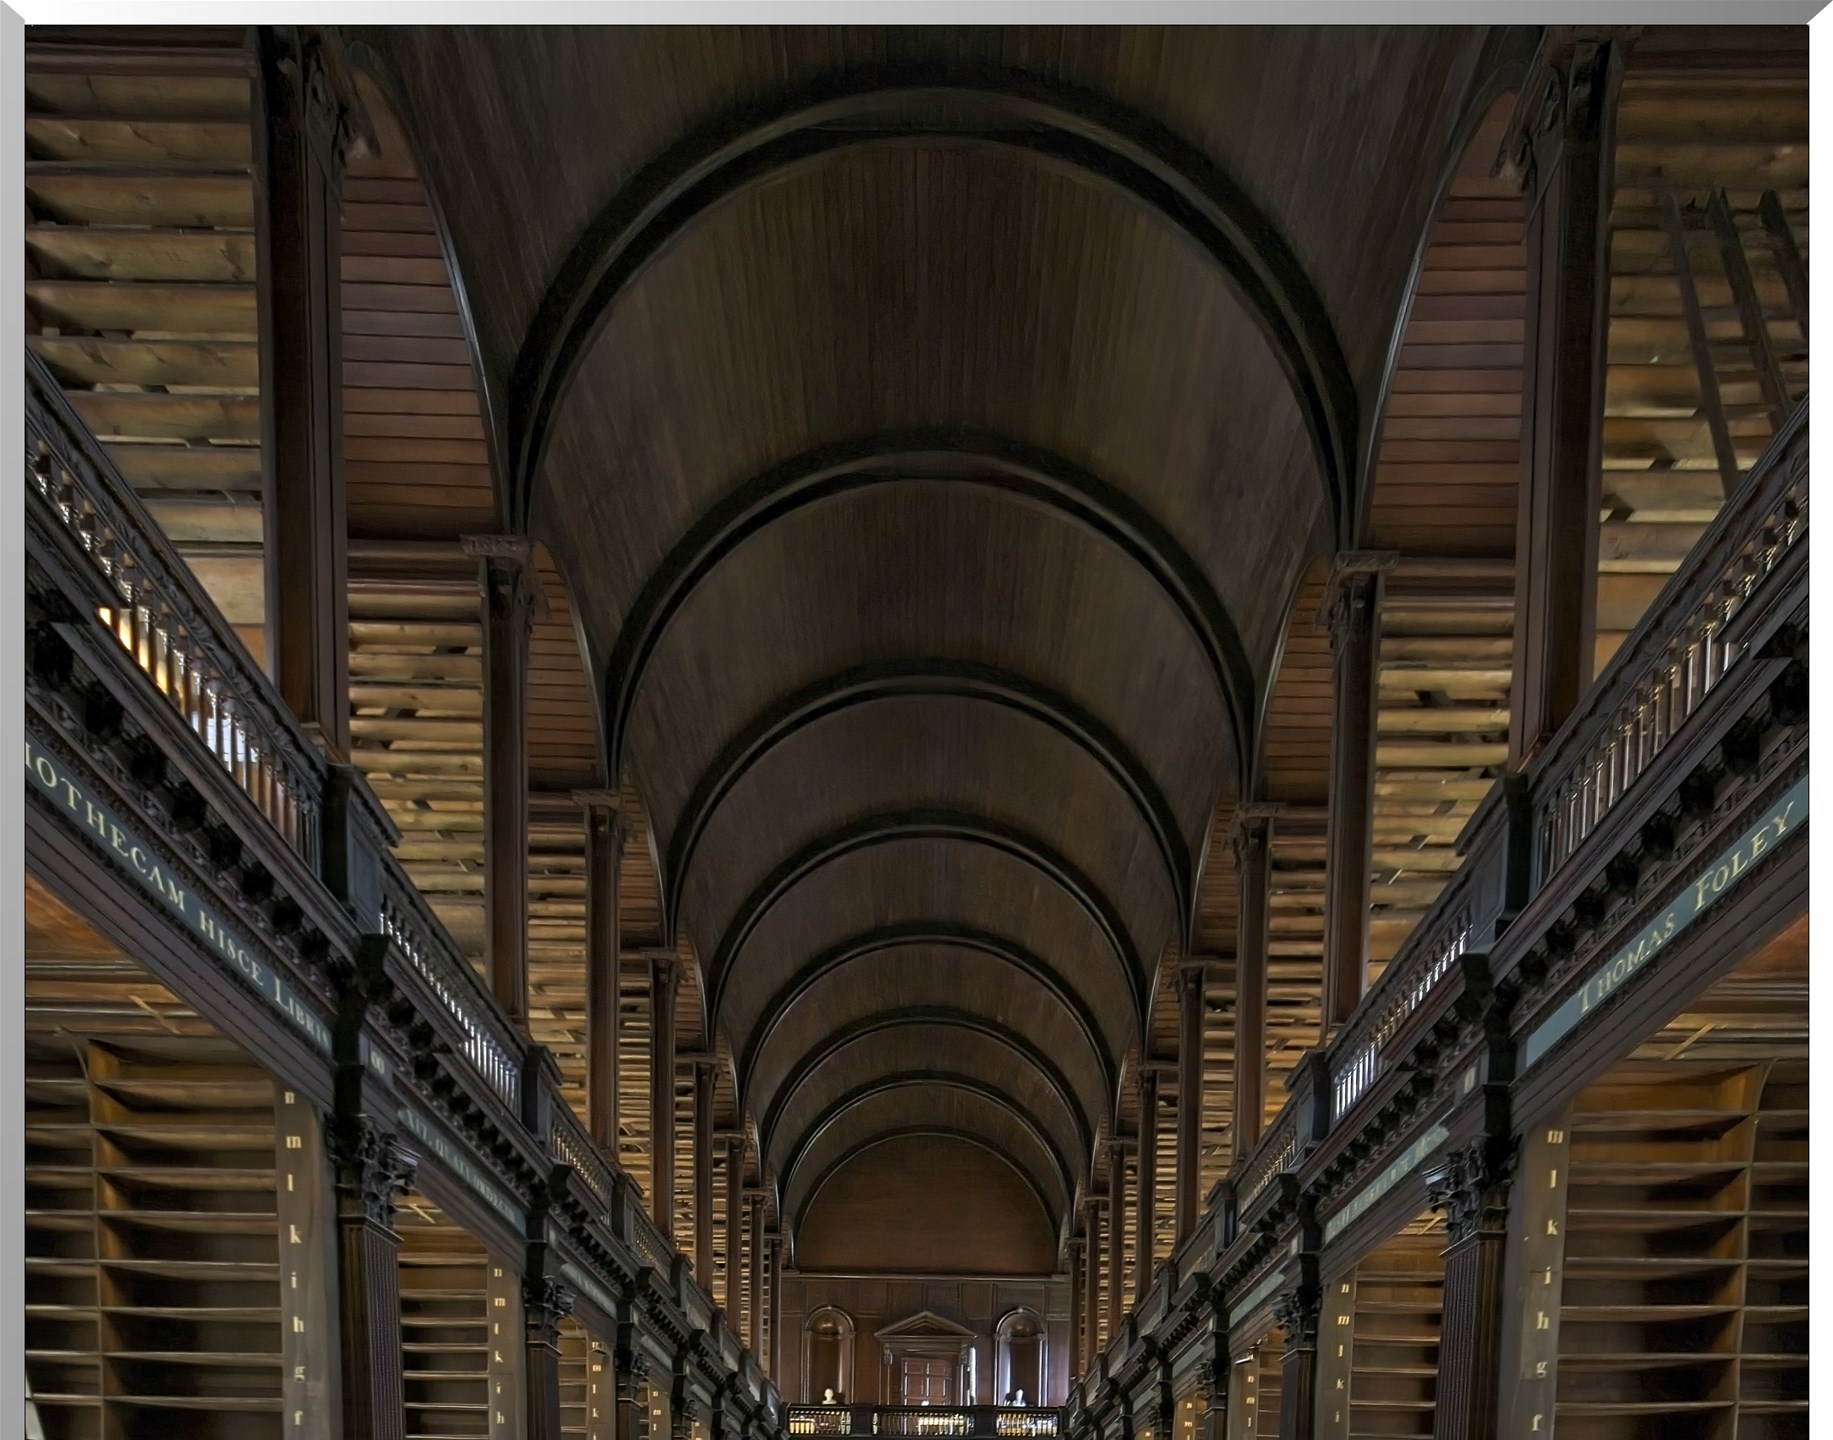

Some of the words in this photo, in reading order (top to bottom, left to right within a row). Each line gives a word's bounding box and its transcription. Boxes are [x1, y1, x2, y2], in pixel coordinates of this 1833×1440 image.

[1578, 912, 1675, 1013] THOMAS
[1694, 801, 1794, 912] FOLEY
[200, 910, 264, 986] HISCE
[285, 1091, 295, 1104] n
[287, 1136, 301, 1149] m
[290, 1225, 301, 1244] k
[1547, 1219, 1559, 1236] k
[291, 1272, 297, 1288] i
[1543, 1266, 1551, 1285] i
[293, 1317, 304, 1332] h
[1537, 1312, 1550, 1330] h
[1536, 1359, 1548, 1377] g
[294, 1410, 303, 1425] f
[1532, 1415, 1543, 1432] f
